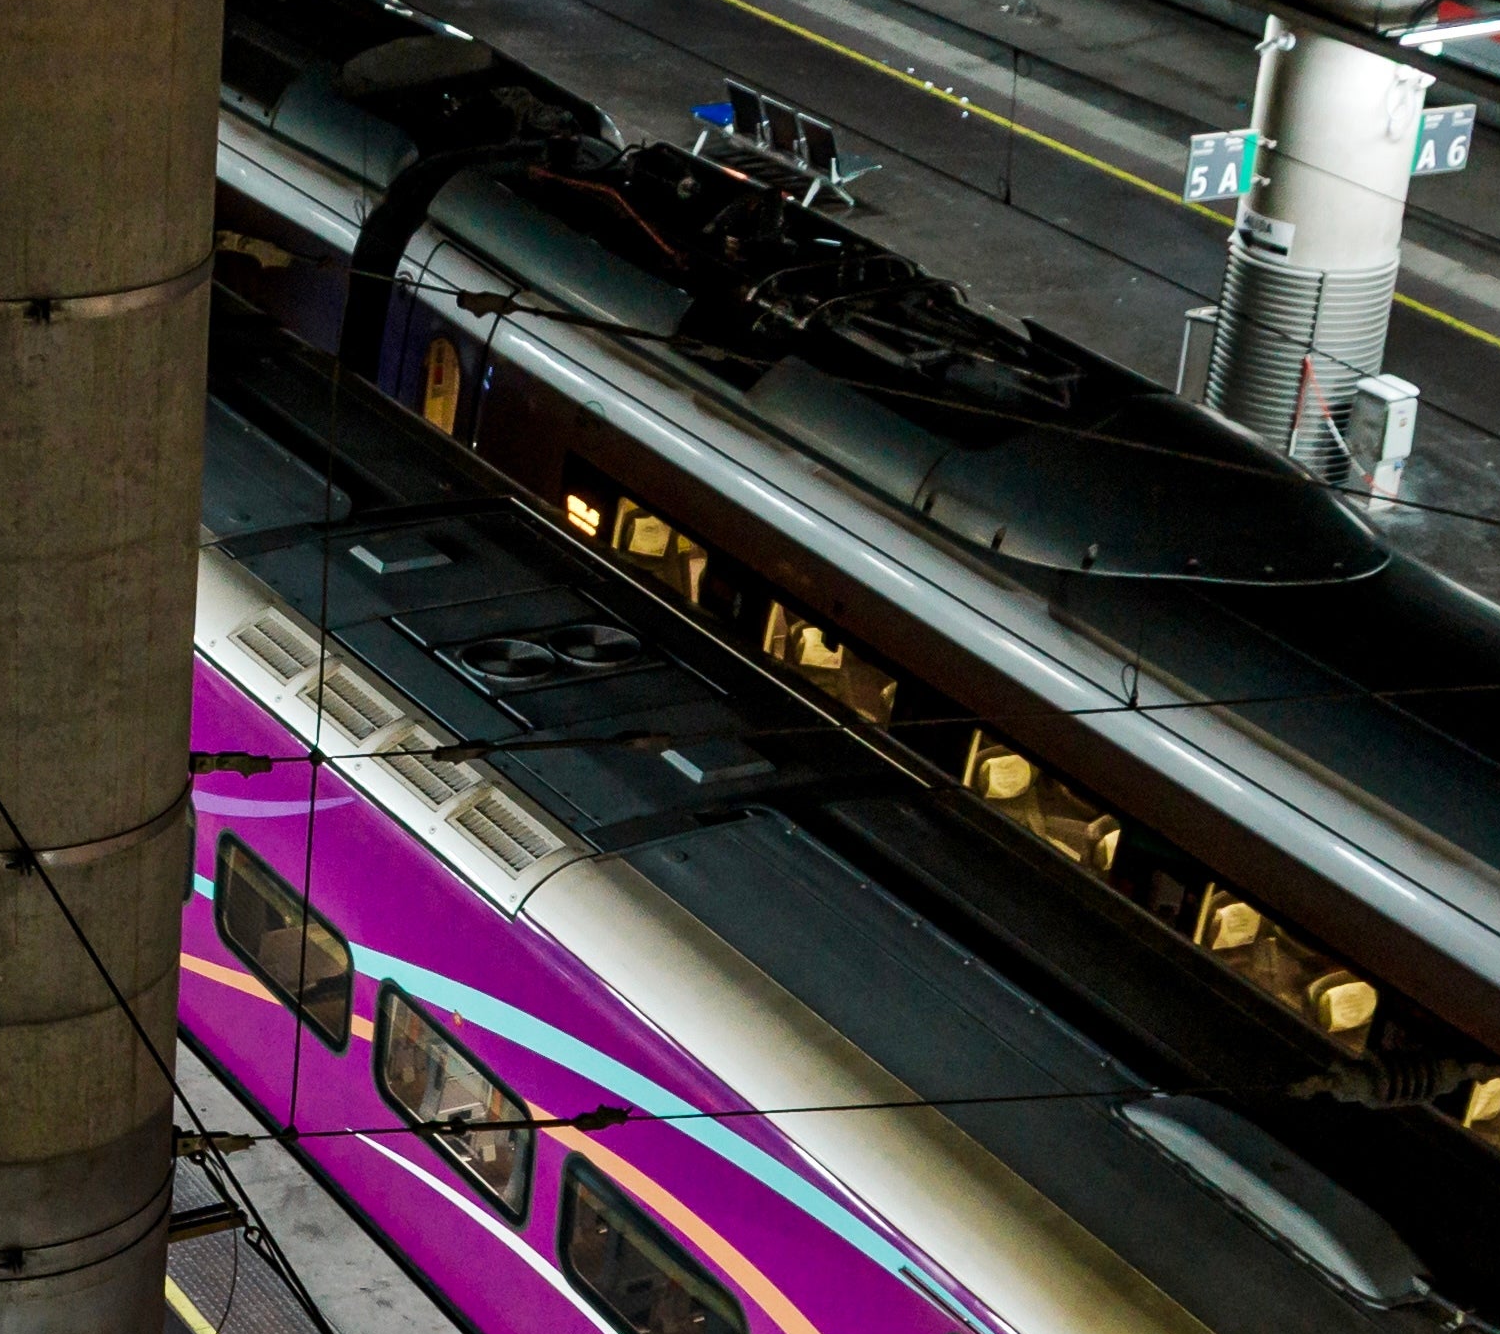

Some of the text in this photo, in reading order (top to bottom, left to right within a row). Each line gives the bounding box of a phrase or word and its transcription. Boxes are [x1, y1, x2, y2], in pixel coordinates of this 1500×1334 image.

[1416, 135, 1467, 170] A 6
[1190, 163, 1238, 198] 5 A
